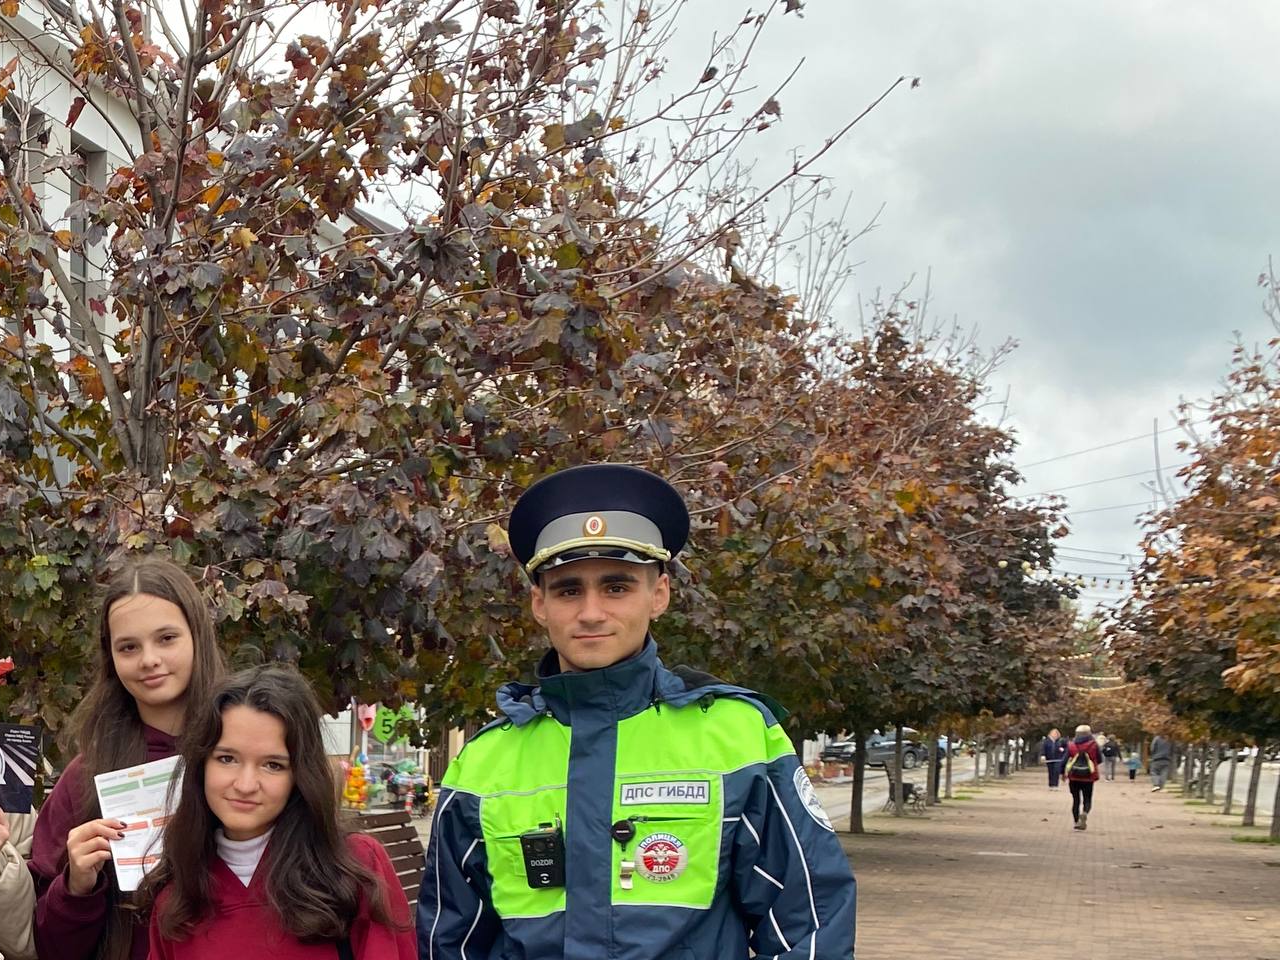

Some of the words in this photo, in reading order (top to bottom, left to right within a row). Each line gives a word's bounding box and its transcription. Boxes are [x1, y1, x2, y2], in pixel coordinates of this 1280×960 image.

[382, 718, 393, 734] 5
[625, 787, 654, 800] ДПС
[659, 785, 706, 799] ГИБДД
[640, 833, 682, 850] ПОЛИЦИЯ
[530, 859, 554, 867] DOZOR
[652, 864, 670, 873] ДПС
